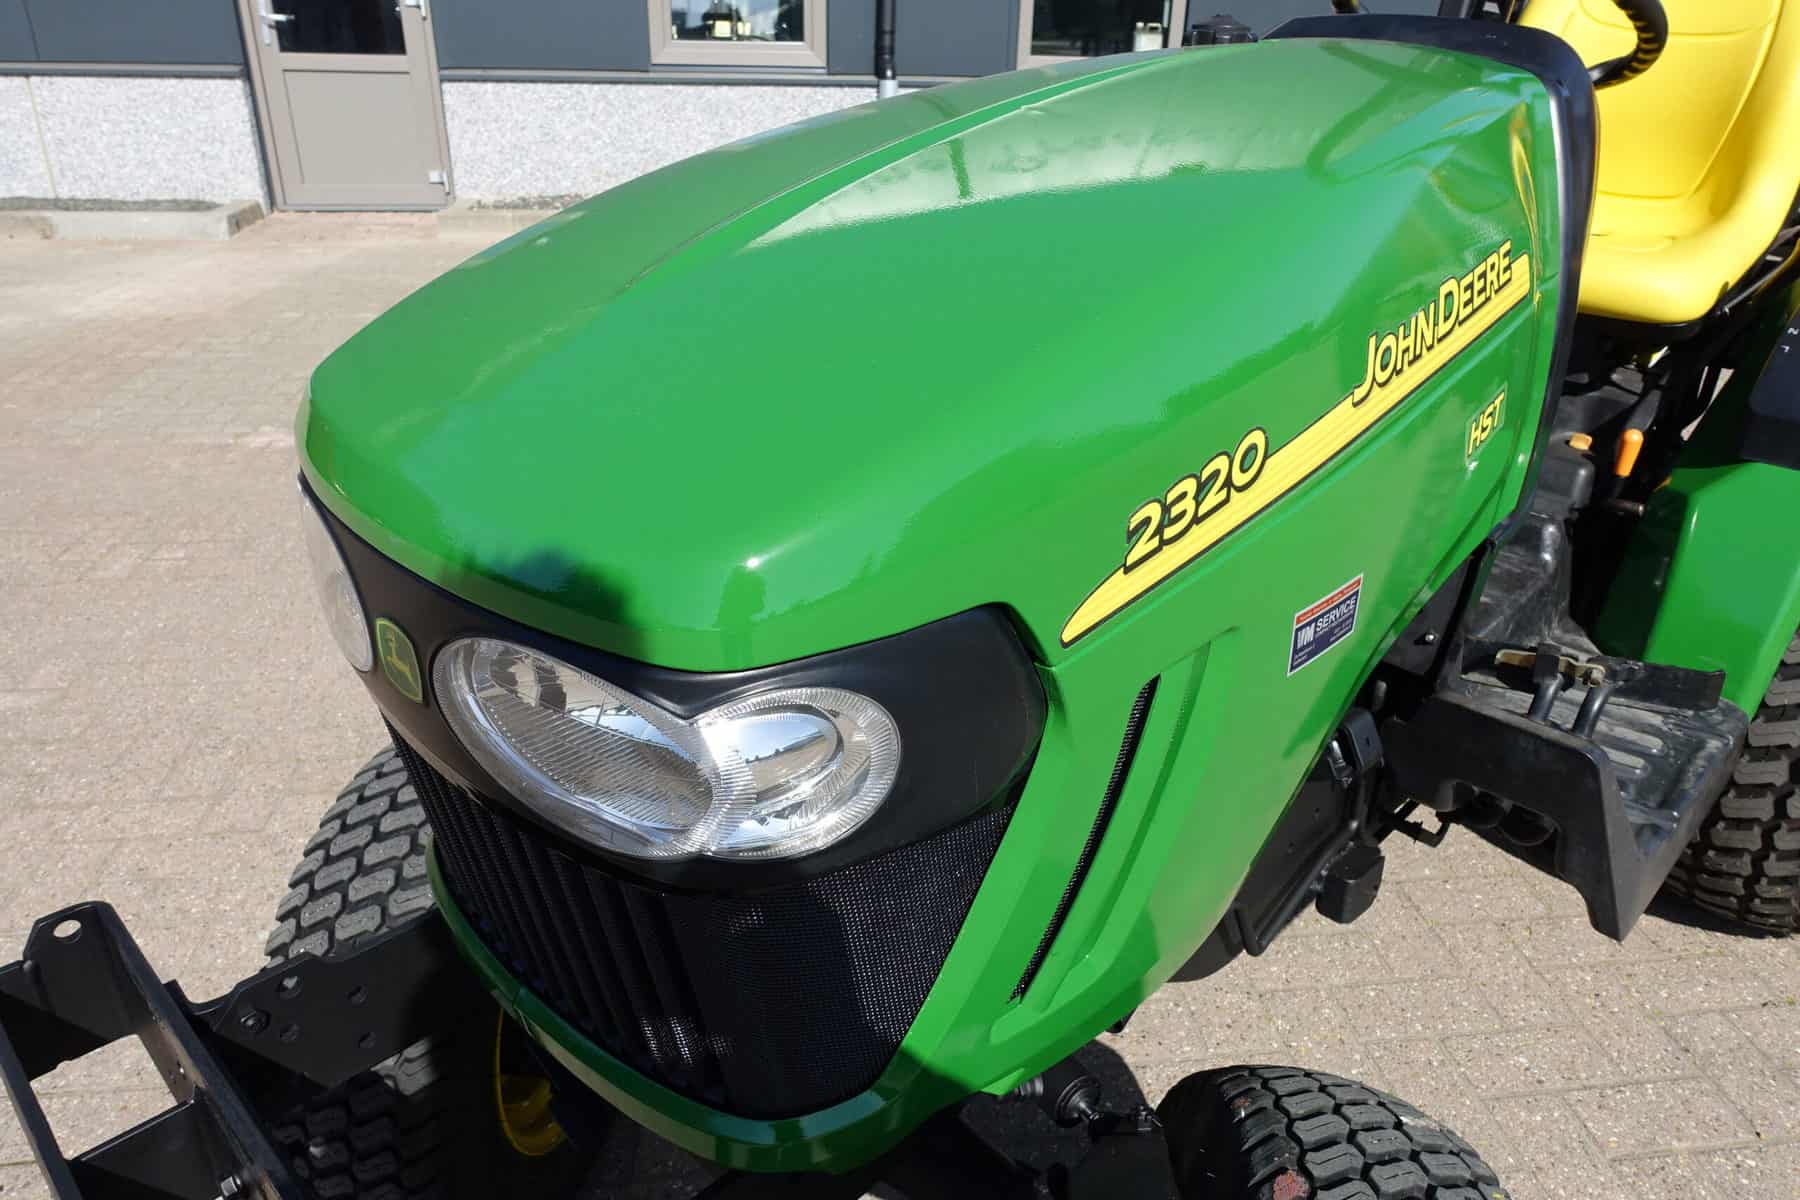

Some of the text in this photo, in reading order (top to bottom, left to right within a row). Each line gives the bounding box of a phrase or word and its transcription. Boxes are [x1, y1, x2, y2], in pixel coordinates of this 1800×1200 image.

[1352, 238, 1513, 407] JOHN DEERE
[1467, 391, 1505, 457] HST
[1123, 426, 1269, 575] 2320
[1315, 595, 1357, 632] SERVICE
